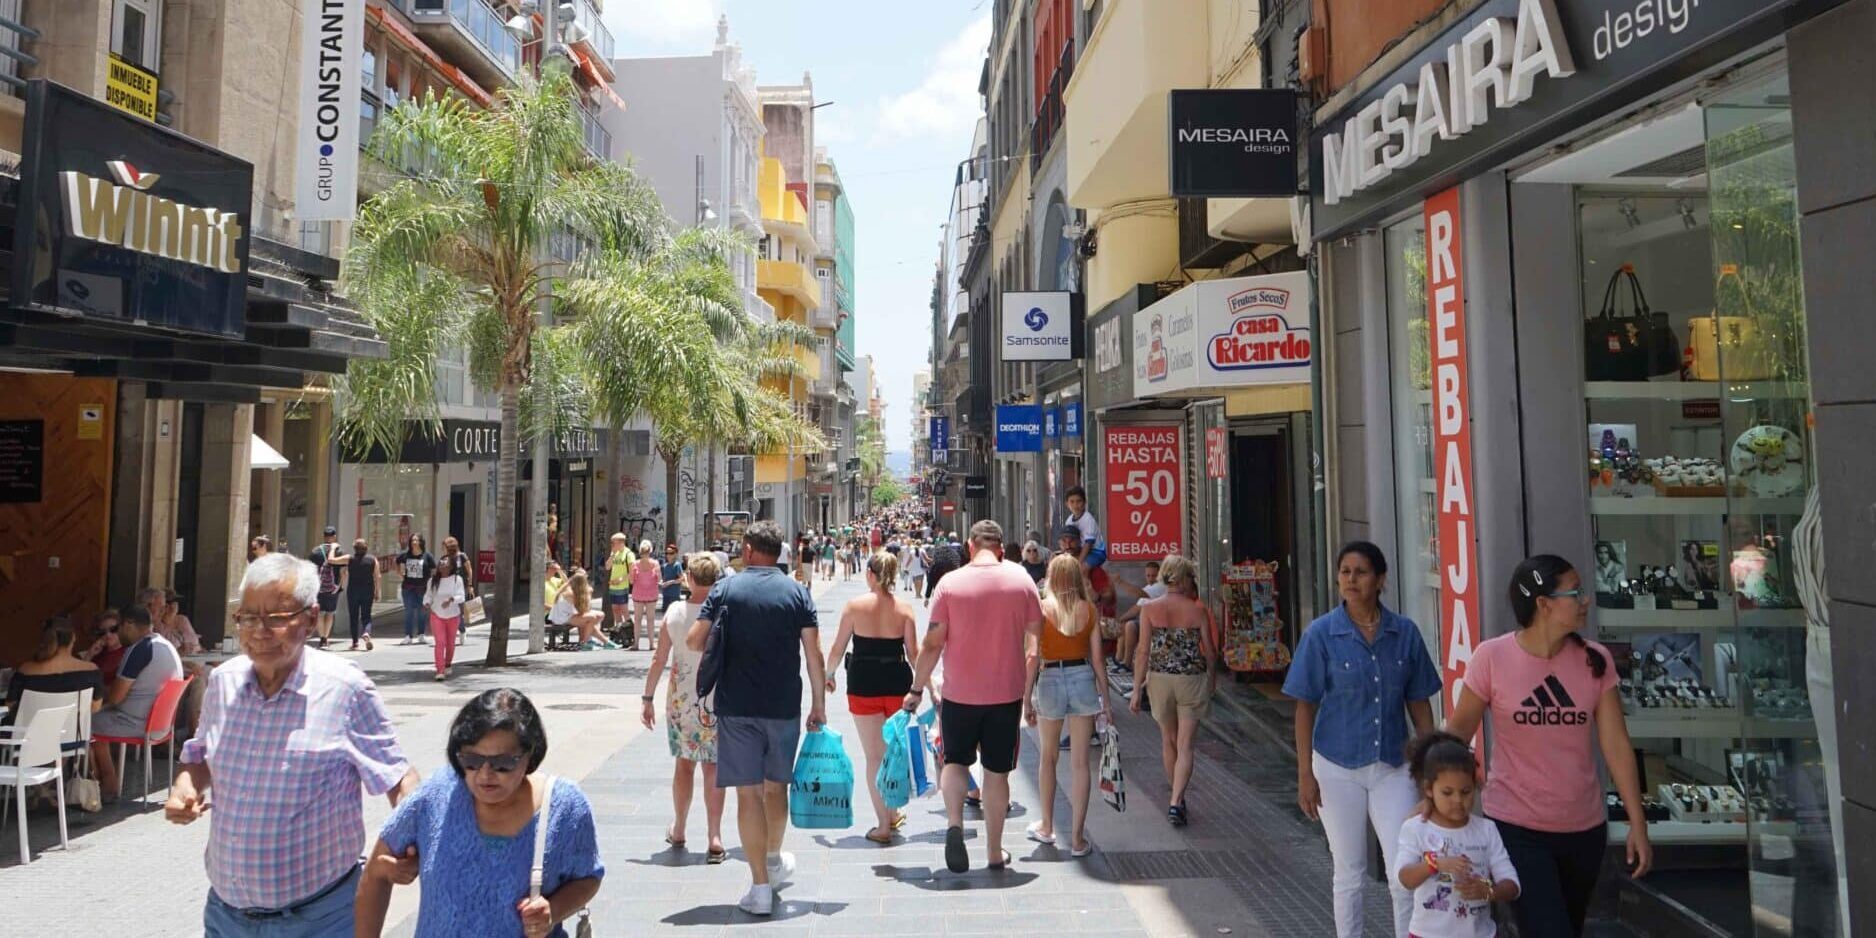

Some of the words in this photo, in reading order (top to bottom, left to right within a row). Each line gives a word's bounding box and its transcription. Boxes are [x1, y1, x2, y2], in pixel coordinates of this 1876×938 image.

[1593, 0, 1699, 60] desig
[111, 63, 152, 95] INMUEBLE
[106, 85, 153, 118] DISPONIBLE
[1323, 0, 1576, 205] MESAIRA
[1178, 128, 1289, 142] MESAIRA
[1244, 143, 1290, 154] design
[1236, 318, 1279, 335] casa
[1006, 335, 1069, 346] Samsonite
[1215, 333, 1310, 364] Ricardo
[1000, 424, 1040, 432] DECATHLON
[1108, 433, 1175, 445] REBAJAS
[1108, 447, 1177, 463] HASTA
[1111, 469, 1175, 505] -50
[1130, 510, 1158, 537] %
[1111, 542, 1178, 554] REBAJAS
[1513, 704, 1588, 725] adidas
